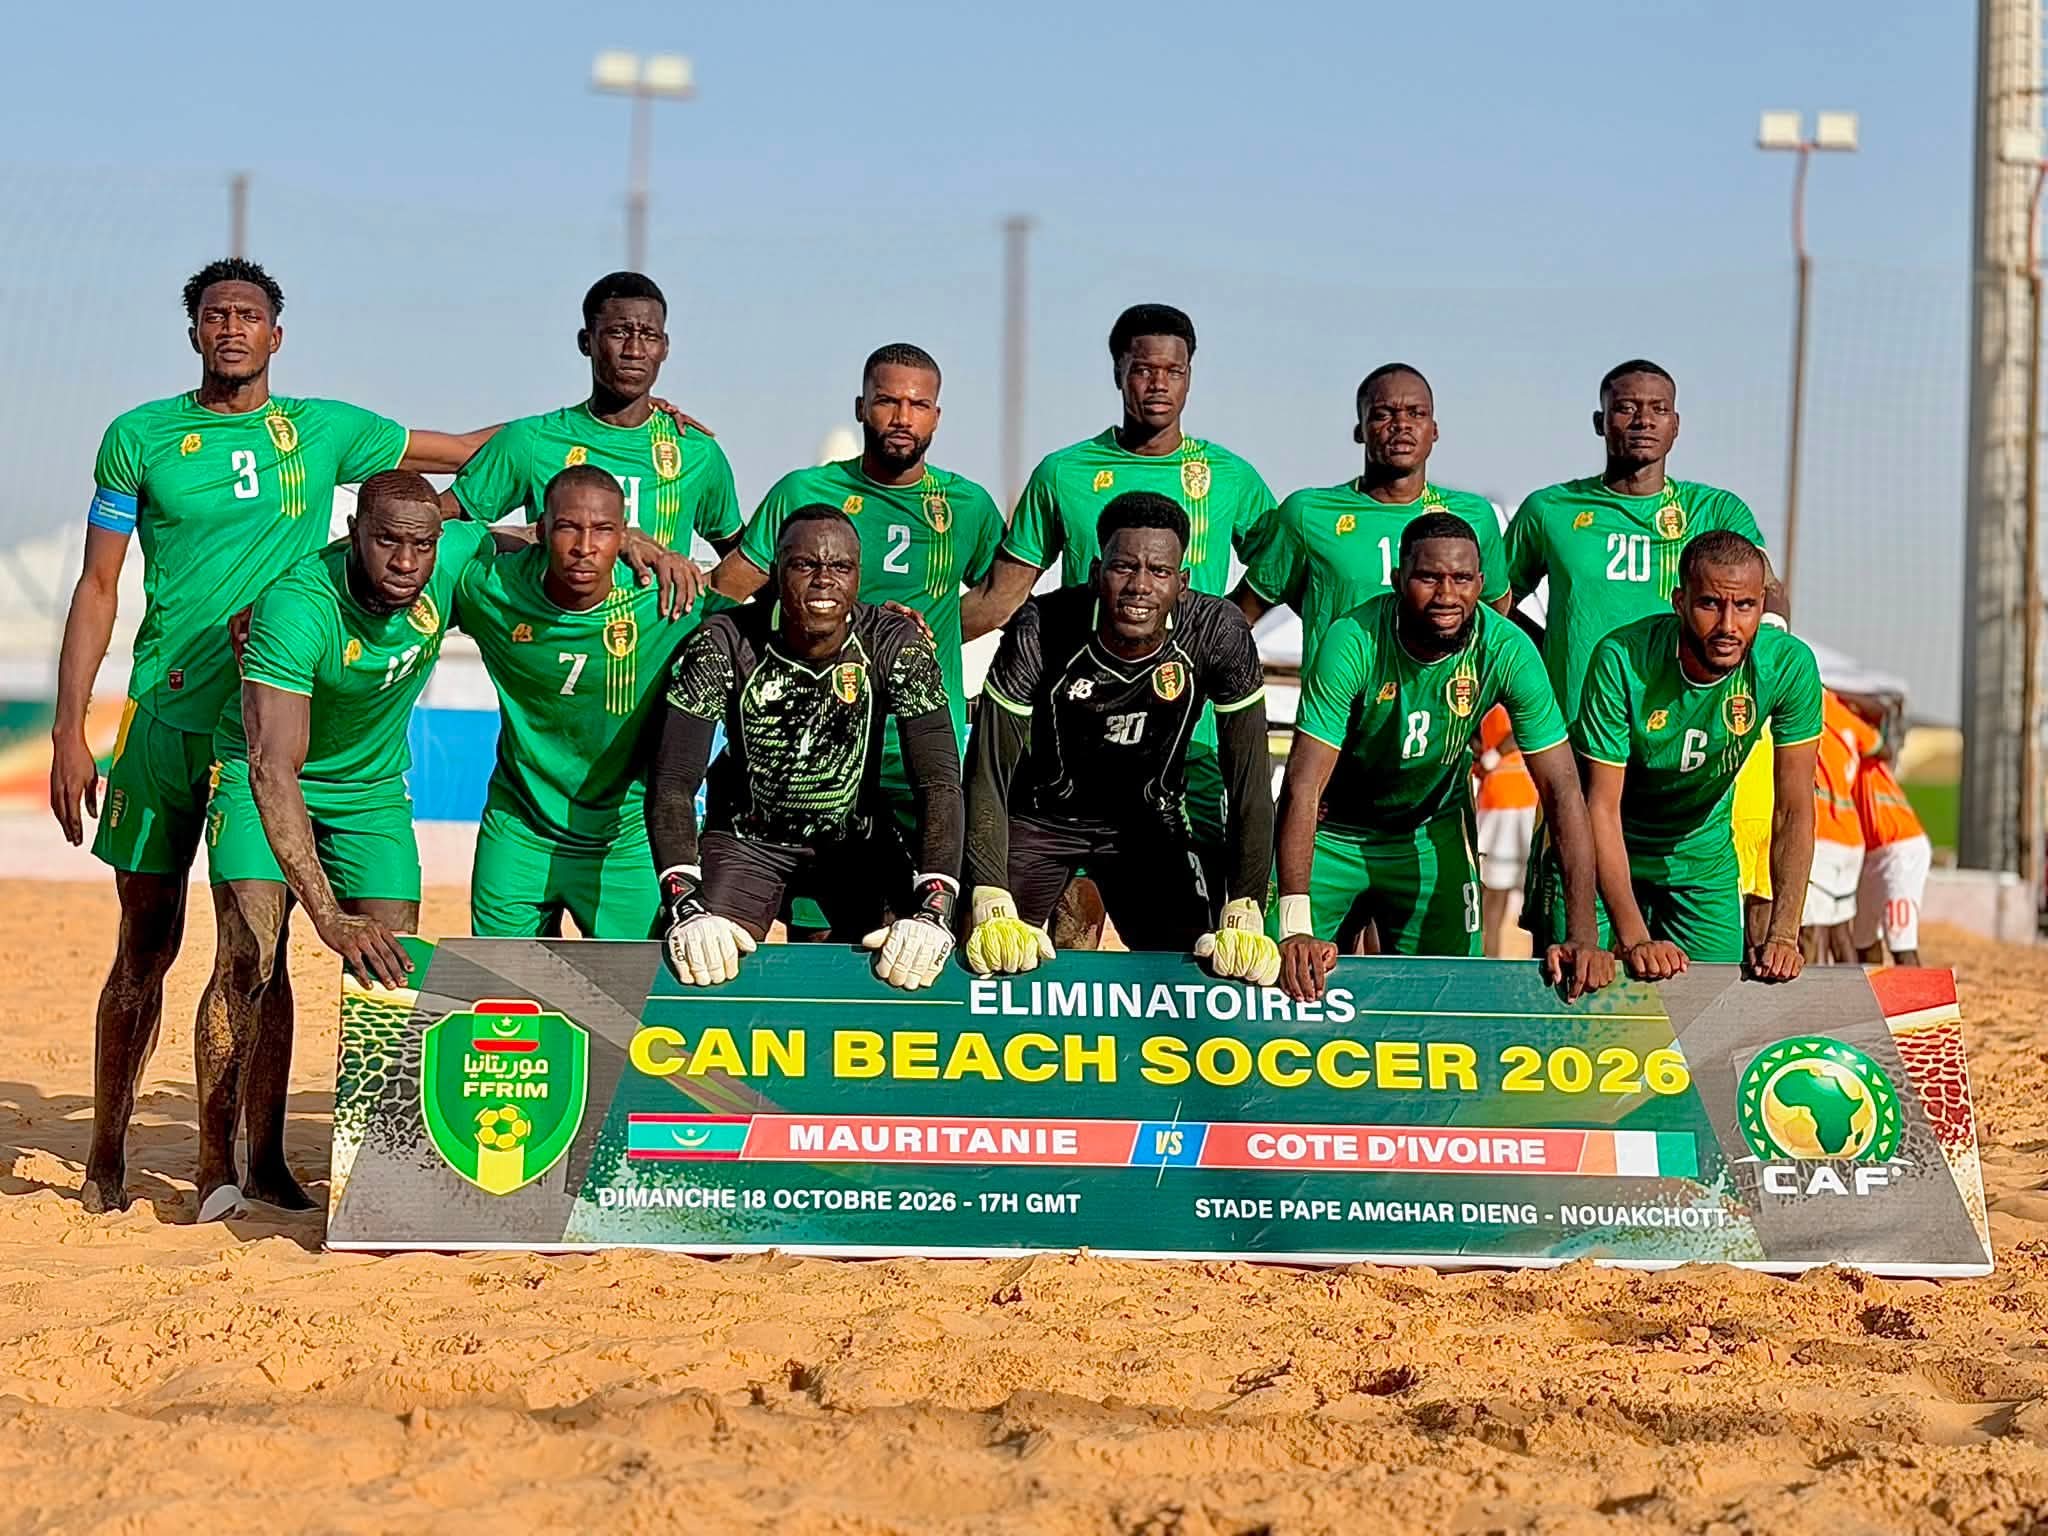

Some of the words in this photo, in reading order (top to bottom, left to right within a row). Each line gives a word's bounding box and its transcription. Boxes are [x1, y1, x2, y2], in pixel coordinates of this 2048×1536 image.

[231, 450, 260, 499] 3
[883, 524, 911, 574] 2
[1606, 532, 1651, 582] 20
[558, 651, 588, 696] 7
[1103, 711, 1149, 745] 30
[1402, 710, 1431, 760] 8
[1680, 728, 1708, 773] 6
[1462, 880, 1480, 934] 8
[1887, 898, 1910, 929] 10
[464, 1053, 549, 1080] موريتانيا
[628, 1027, 806, 1078] CAN
[833, 1031, 1118, 1083] BEACH
[1141, 1037, 1479, 1091] SOCCER
[1501, 1047, 1690, 1096] 2026
[463, 1081, 549, 1098] FFRIM
[788, 1124, 1079, 1156] MAURITANIE
[1155, 1131, 1184, 1156] VS
[1247, 1133, 1359, 1161] COTE
[1367, 1135, 1547, 1165] D'IVOIRE
[1763, 1165, 1890, 1196] CAF
[597, 1187, 737, 1209] DIMANCHE
[742, 1189, 766, 1209] 18
[773, 1189, 892, 1210] OCTOBRE
[898, 1191, 957, 1211] 2026
[978, 1193, 1018, 1213] 17H
[1026, 1193, 1082, 1214] GMT
[1195, 1198, 1273, 1219] STADE
[1280, 1200, 1342, 1220] PAPE
[1348, 1202, 1455, 1222] AMGHAR
[1461, 1203, 1538, 1224] DIENG
[1560, 1205, 1728, 1228] NOUAKCHOTT
